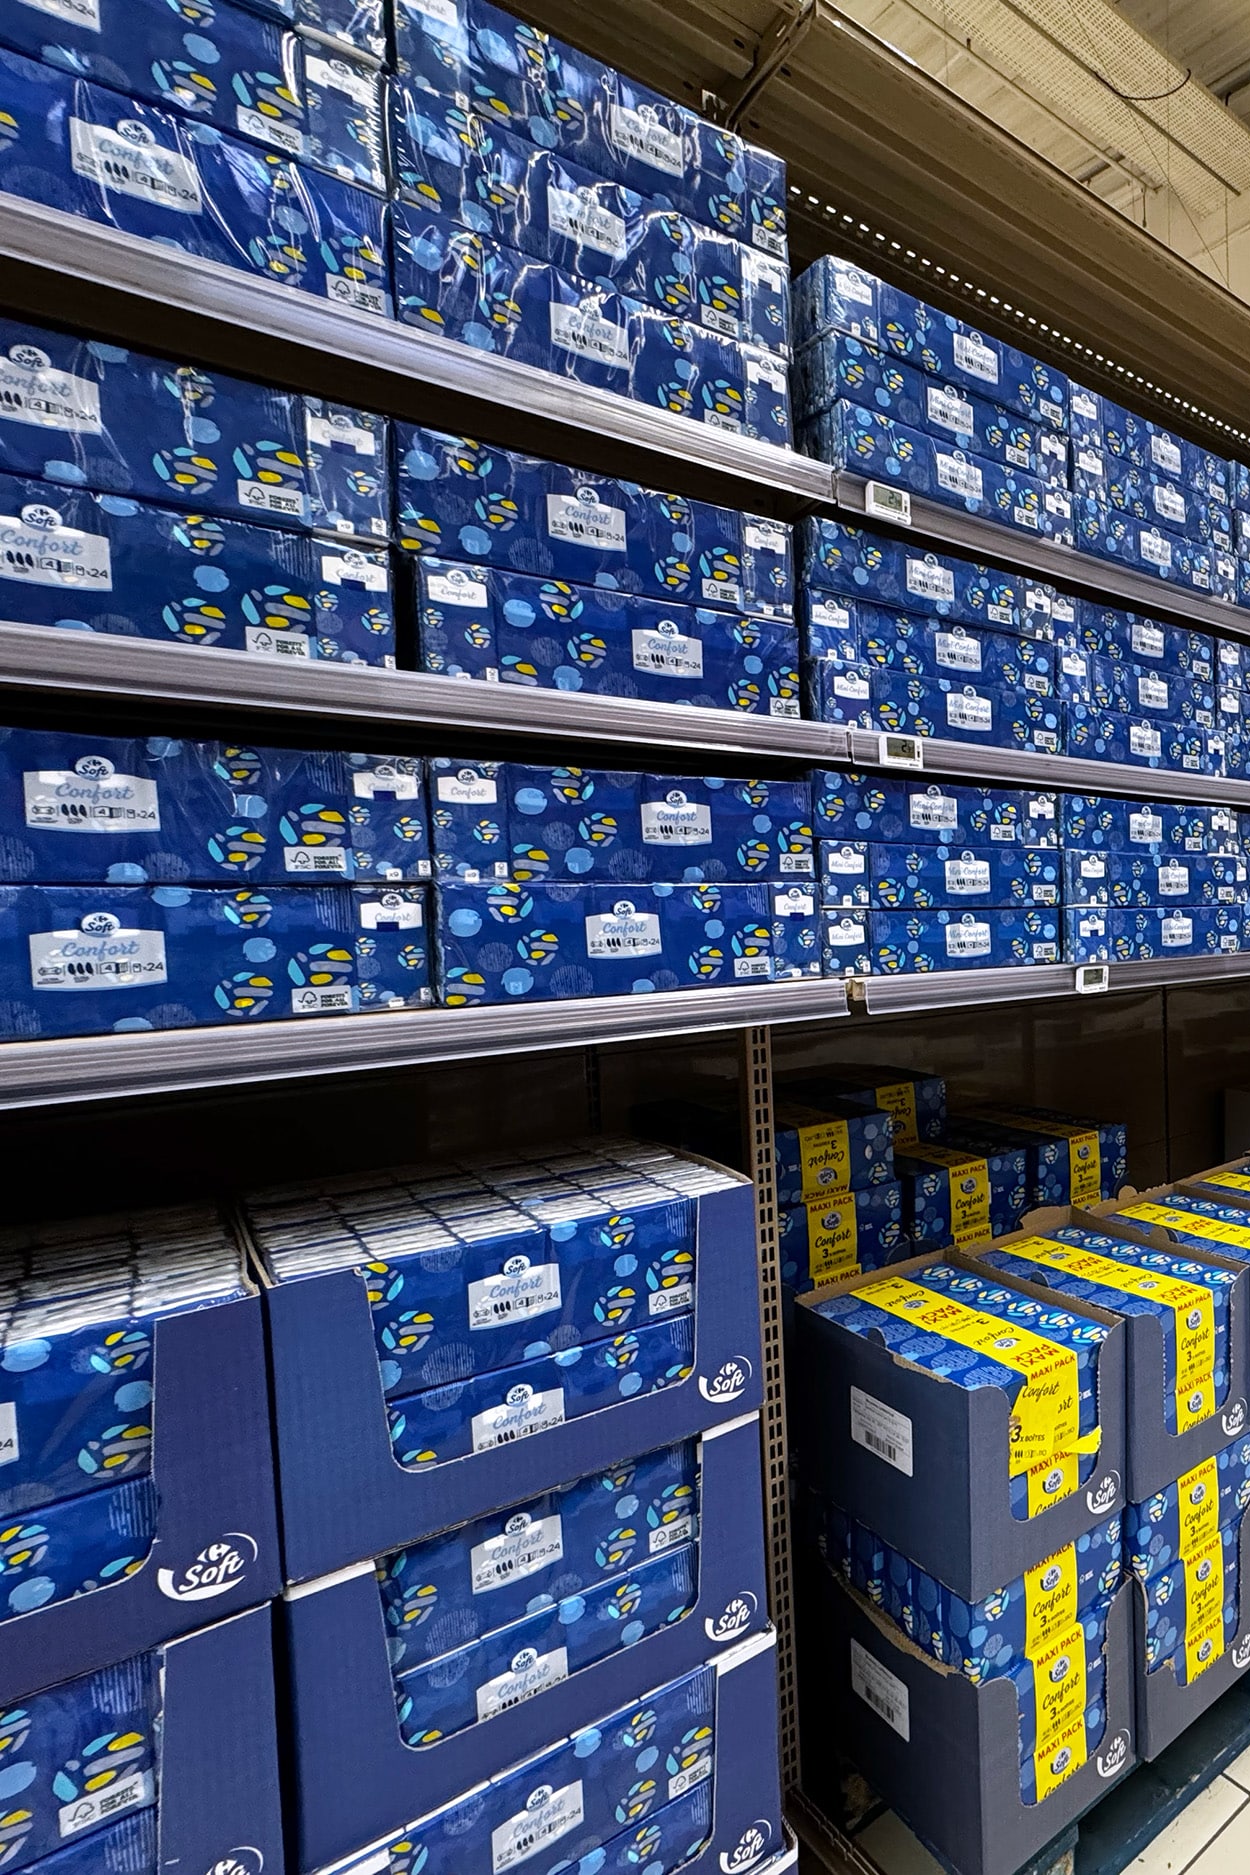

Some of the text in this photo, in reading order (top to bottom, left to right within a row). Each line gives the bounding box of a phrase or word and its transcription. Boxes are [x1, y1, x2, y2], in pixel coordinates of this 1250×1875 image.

[99, 139, 176, 178] Confort
[0, 368, 71, 398] onfort
[564, 506, 611, 526] Confort
[2, 530, 83, 556] Confort
[648, 639, 688, 657] Confort
[79, 763, 109, 779] Soft
[55, 783, 135, 804] Confort
[450, 787, 487, 800] Confort
[656, 810, 698, 826] Confort
[86, 920, 116, 936] Soft
[602, 922, 647, 941] Confort
[61, 941, 141, 961] Confort
[952, 1163, 987, 1178] MAXI PACK
[810, 1196, 855, 1213] MAXI PACK
[955, 1194, 985, 1210] Confort
[815, 1229, 851, 1248] Confort
[503, 1261, 527, 1276] Soft
[817, 1268, 861, 1289] MAXI PACK
[489, 1276, 543, 1301] Confort
[1177, 1292, 1212, 1312] MAXI PACK
[1180, 1328, 1209, 1351] Confort
[1010, 1343, 1050, 1362] PACK
[1020, 1348, 1060, 1367] MAXI
[1030, 1354, 1076, 1381] MAXI PACK
[710, 1369, 746, 1395] Soft
[1022, 1381, 1060, 1402] Confort
[1177, 1373, 1213, 1396] MAXI PACK
[507, 1391, 531, 1405] Soft
[493, 1402, 547, 1431] Confort
[1228, 1409, 1244, 1431] Soft
[1010, 1424, 1022, 1443] 3
[1030, 1459, 1052, 1477] MAXI
[1180, 1462, 1216, 1490] MAXI PACK
[1095, 1481, 1118, 1507] Soft
[1184, 1499, 1214, 1528] Confort
[491, 1533, 544, 1561] Confort
[1186, 1539, 1220, 1567] MAXI PACK
[179, 1551, 245, 1592] Soft
[1190, 1574, 1219, 1603] Confort
[1033, 1583, 1072, 1618] Confort
[715, 1604, 751, 1634] Soft
[1187, 1619, 1222, 1648] MAXI PACK
[1036, 1631, 1082, 1669] MAXI PACK
[499, 1662, 551, 1698] Confort
[1042, 1672, 1080, 1710] Confort
[1037, 1721, 1083, 1762] MAXI PACK
[1104, 1742, 1126, 1770] Soft
[512, 1800, 568, 1836] Confort
[732, 1834, 766, 1867] Soft
